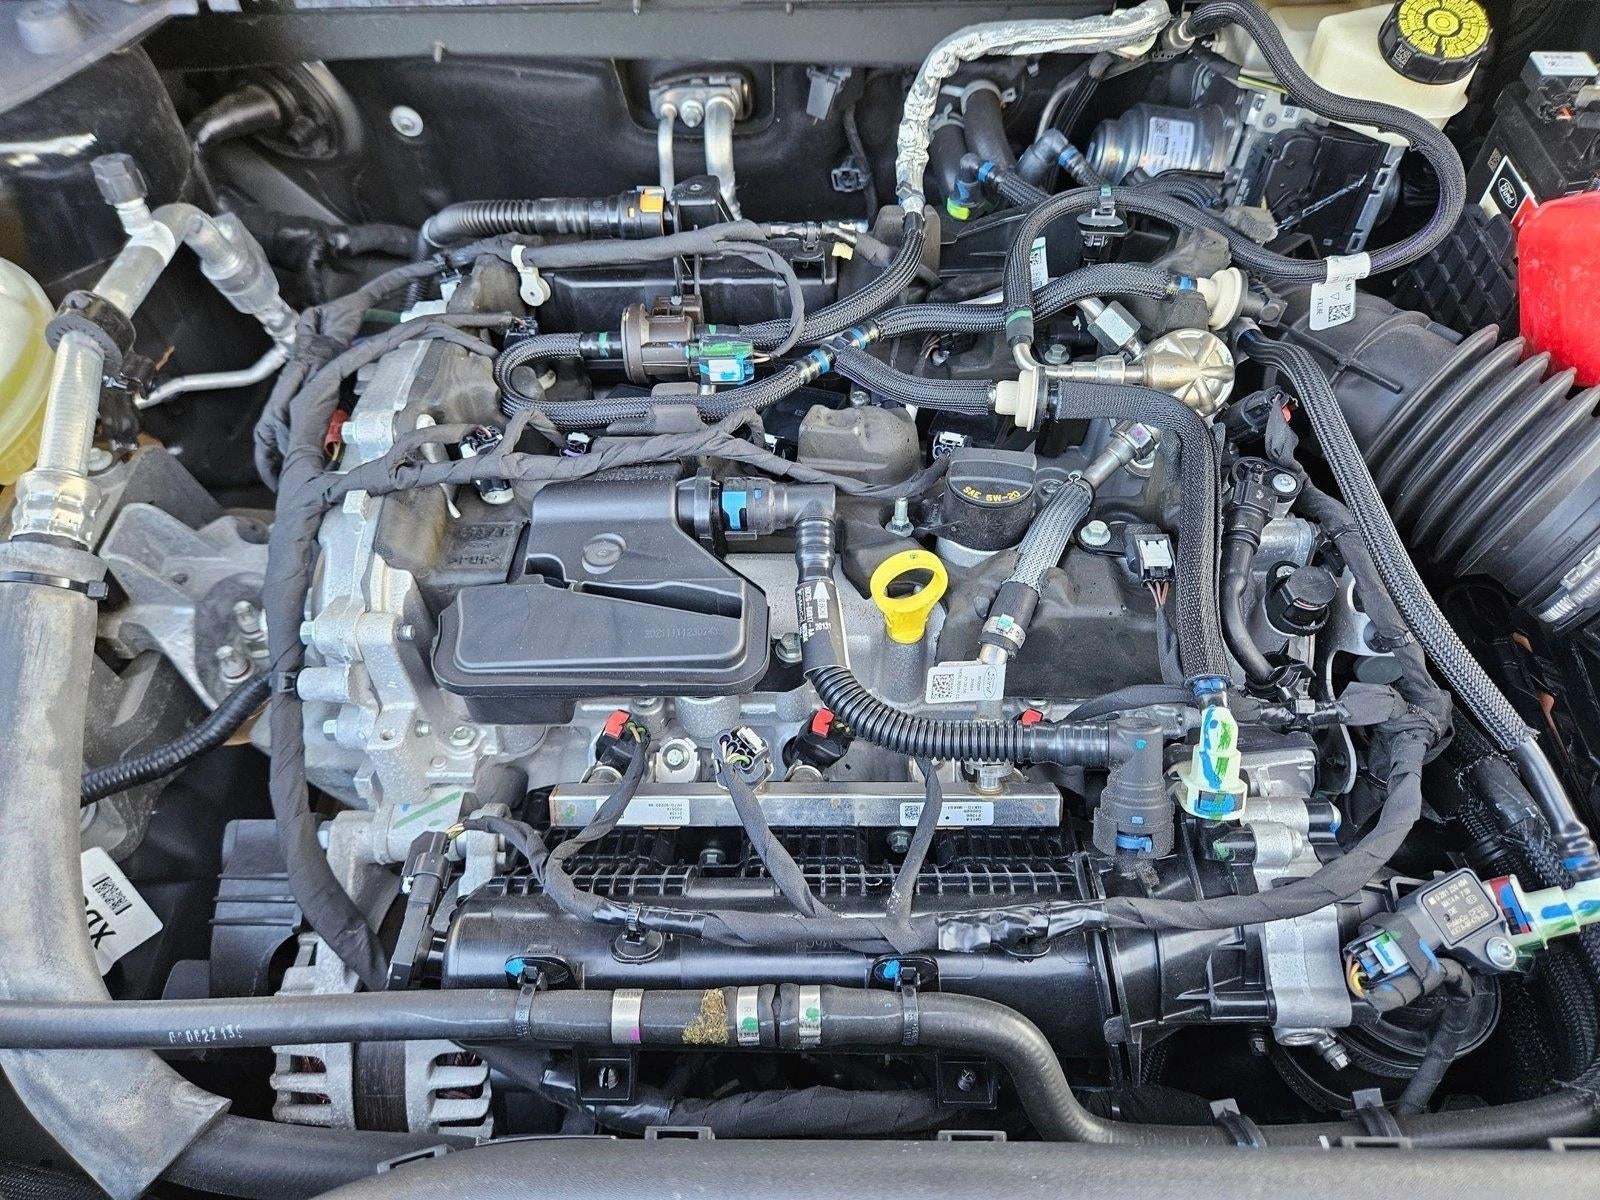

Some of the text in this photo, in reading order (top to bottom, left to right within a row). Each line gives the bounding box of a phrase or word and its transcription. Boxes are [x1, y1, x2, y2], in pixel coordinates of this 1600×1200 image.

[1499, 182, 1515, 205] Ford
[962, 486, 1021, 502] SAE 5W-20
